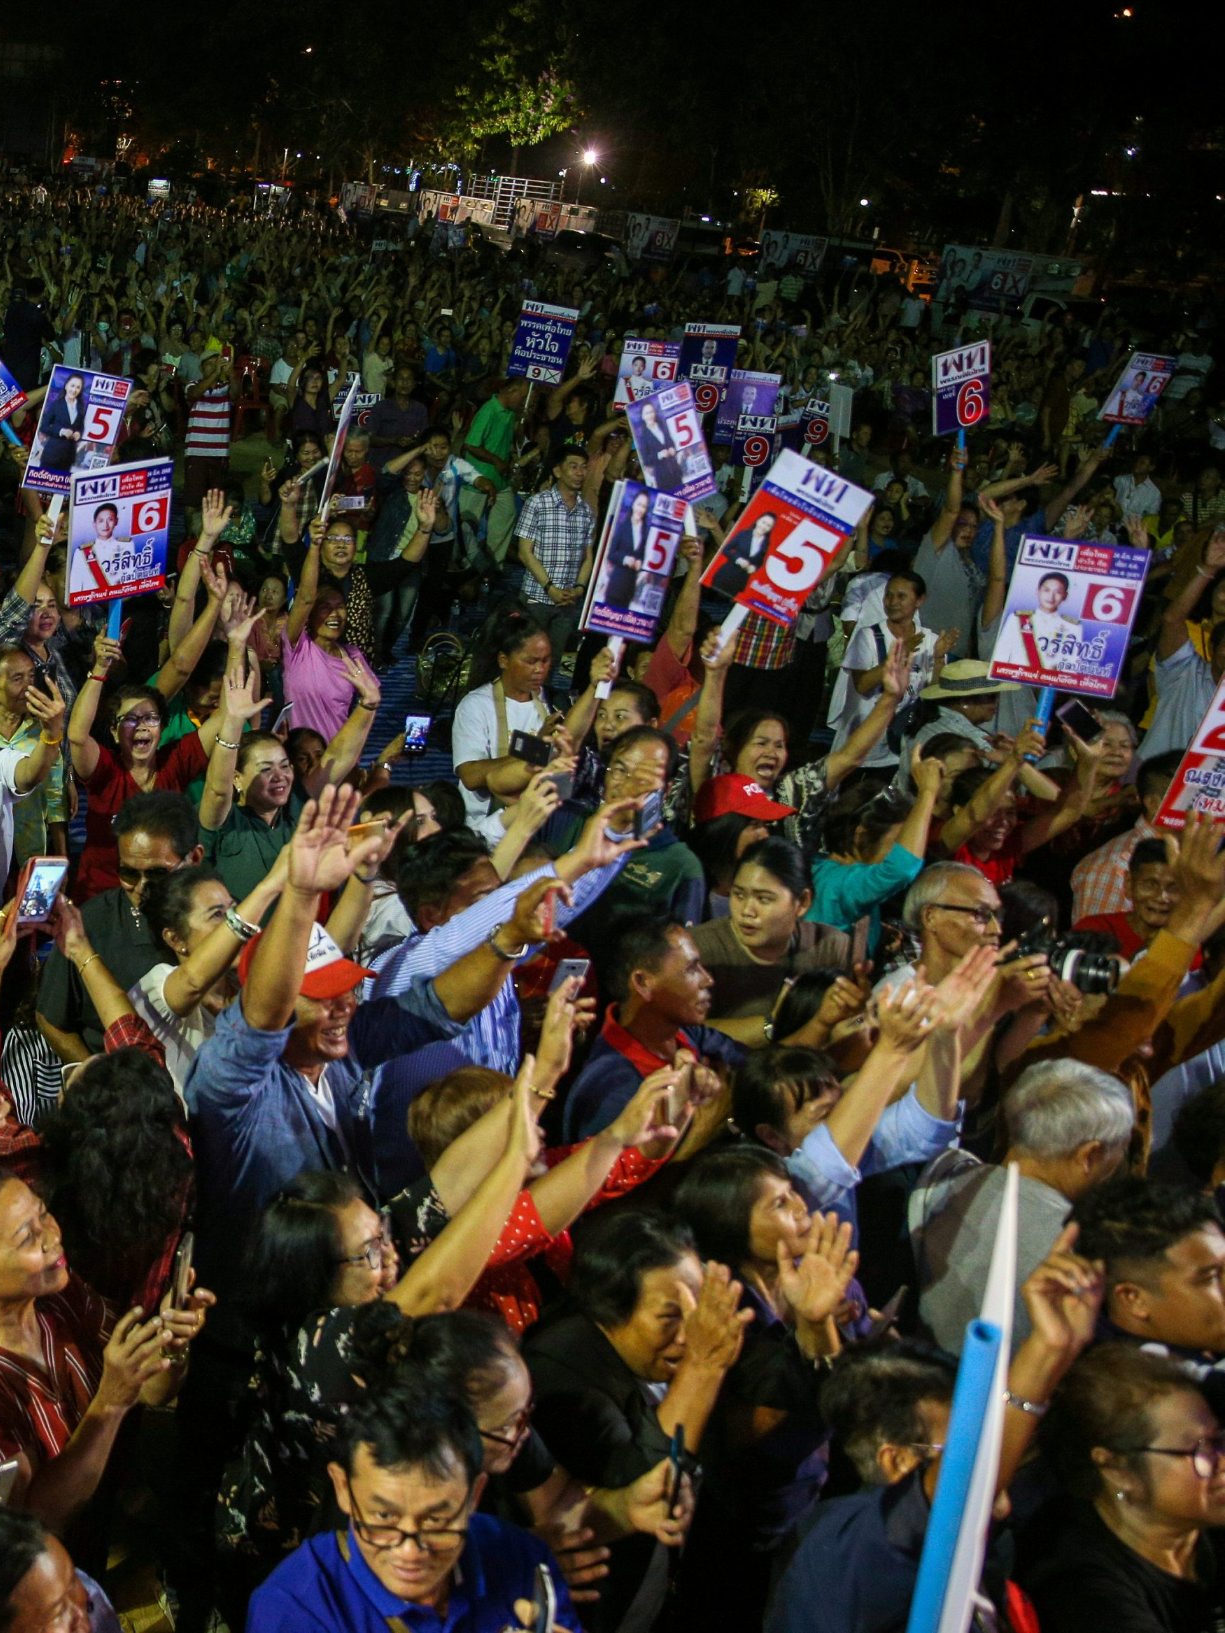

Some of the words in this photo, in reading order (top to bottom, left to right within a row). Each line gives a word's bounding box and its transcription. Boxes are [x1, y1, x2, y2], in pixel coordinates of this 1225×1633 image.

[520, 320, 572, 336] พรรคเพื่อไทย
[526, 331, 559, 353] หัวใจ
[514, 346, 563, 364] คือประชาชน
[941, 346, 986, 377] พท
[532, 368, 541, 378] 9
[656, 363, 671, 380] 6
[694, 384, 719, 414] 9
[956, 378, 984, 426] 6
[87, 408, 113, 440] 5
[674, 414, 693, 446] 5
[804, 418, 829, 445] 9
[742, 436, 770, 467] 9
[80, 478, 116, 497] พท
[138, 501, 160, 532] 6
[648, 531, 672, 570] 5
[765, 518, 841, 592] 5
[1028, 542, 1074, 562] พท
[1092, 586, 1125, 622] 6
